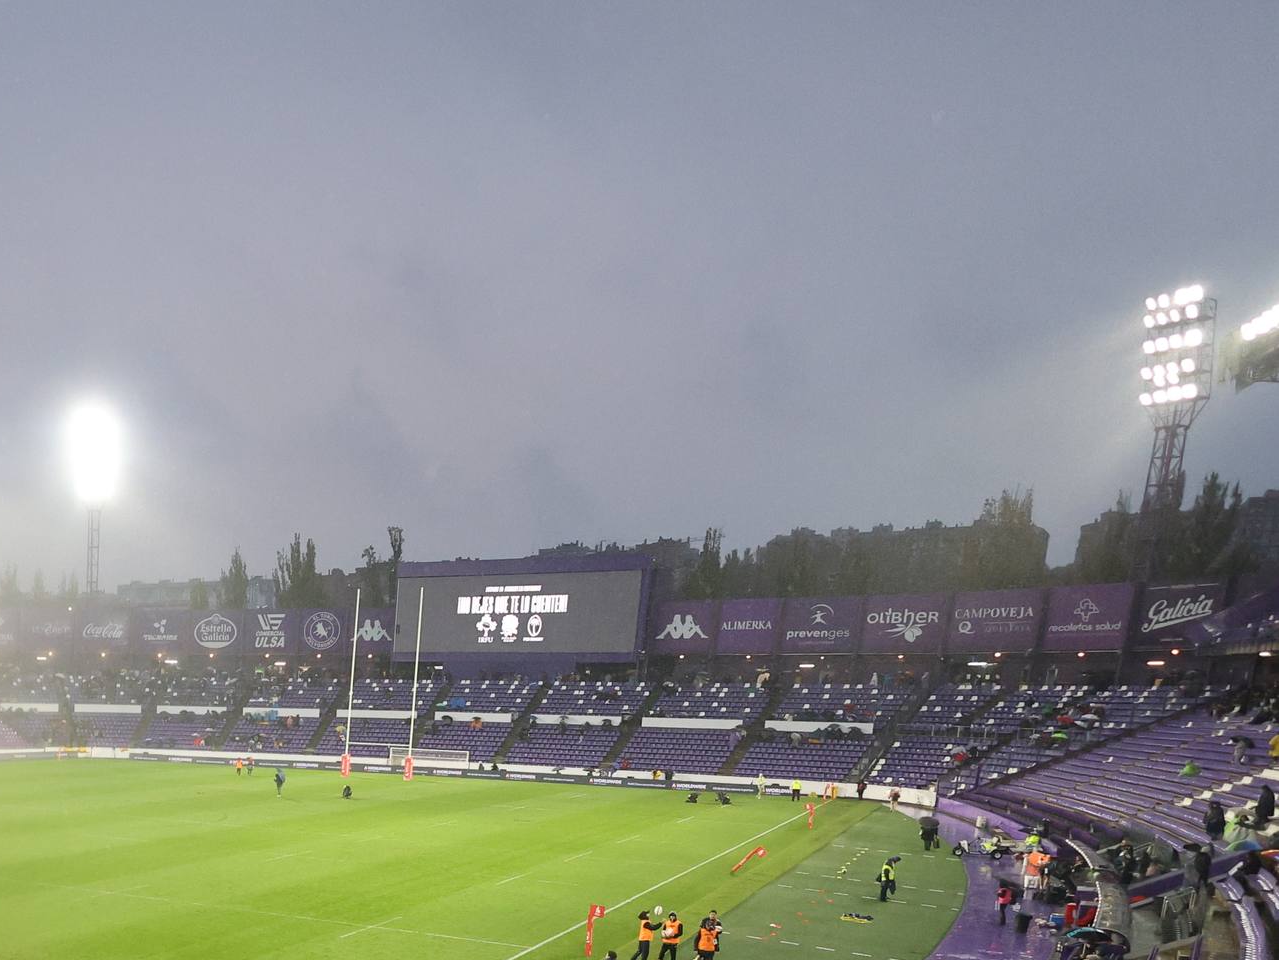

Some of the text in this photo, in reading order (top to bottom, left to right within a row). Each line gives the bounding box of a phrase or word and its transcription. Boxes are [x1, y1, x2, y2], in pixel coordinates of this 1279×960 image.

[955, 607, 1034, 619] CAMPOVEJA
[200, 624, 232, 633] Estrella
[722, 621, 772, 630] ALIMERKA
[1095, 621, 1121, 631] salud
[201, 632, 230, 641] Galicia
[255, 637, 285, 648] ULSA
